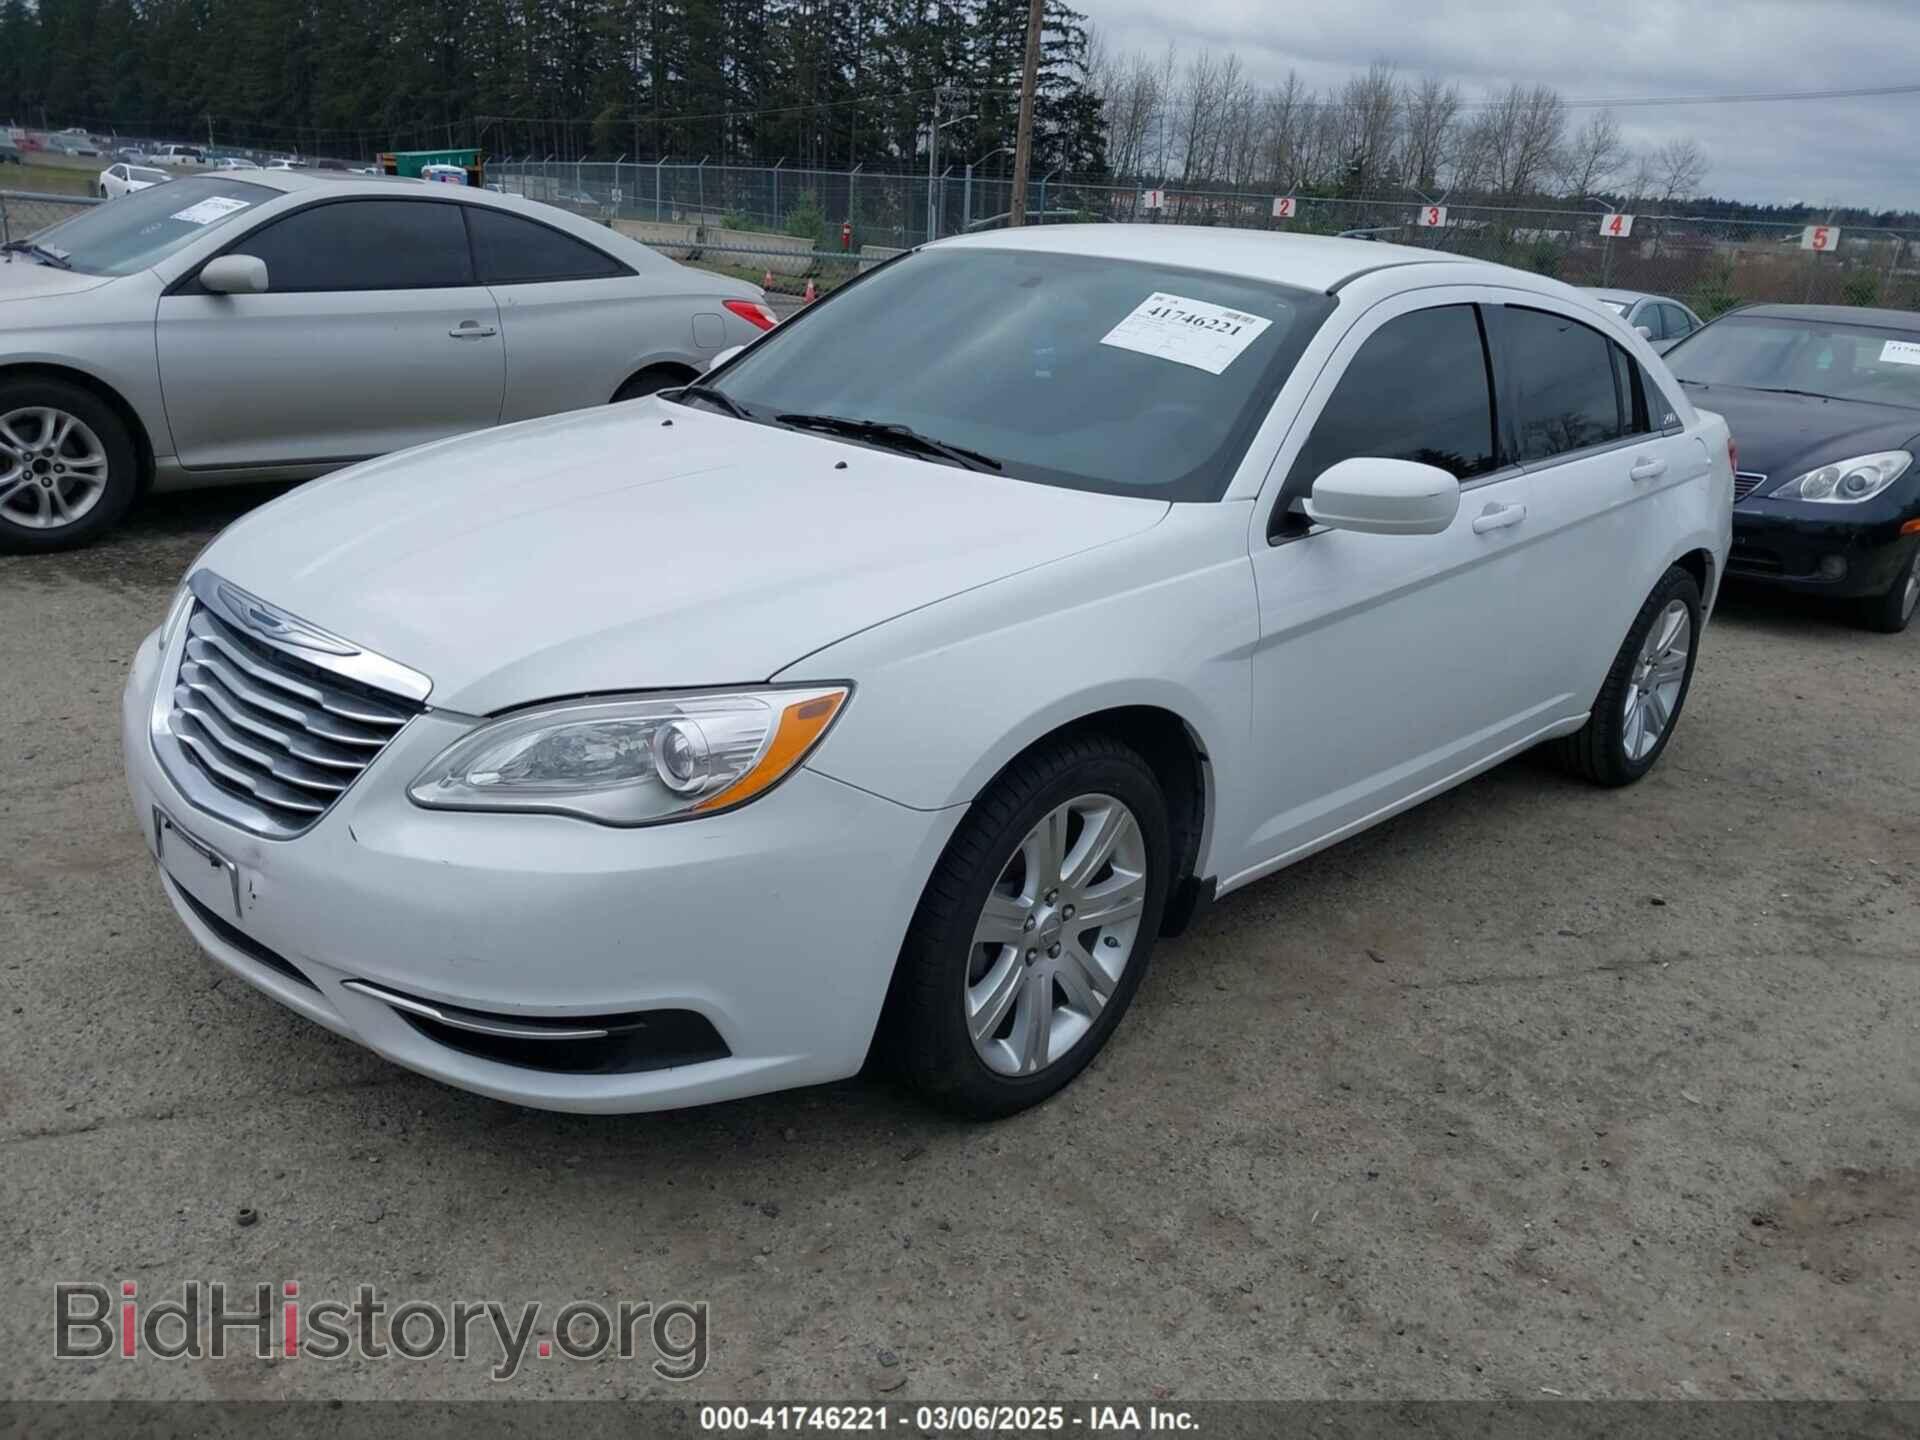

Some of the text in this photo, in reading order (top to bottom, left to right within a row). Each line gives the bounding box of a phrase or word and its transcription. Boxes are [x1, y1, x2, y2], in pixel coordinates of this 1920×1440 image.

[1151, 192, 1157, 207] 1
[1279, 199, 1290, 216] 2
[1428, 207, 1439, 225] 3
[1610, 215, 1624, 235] 4
[1812, 228, 1829, 249] 5
[1147, 306, 1242, 336] 41746221
